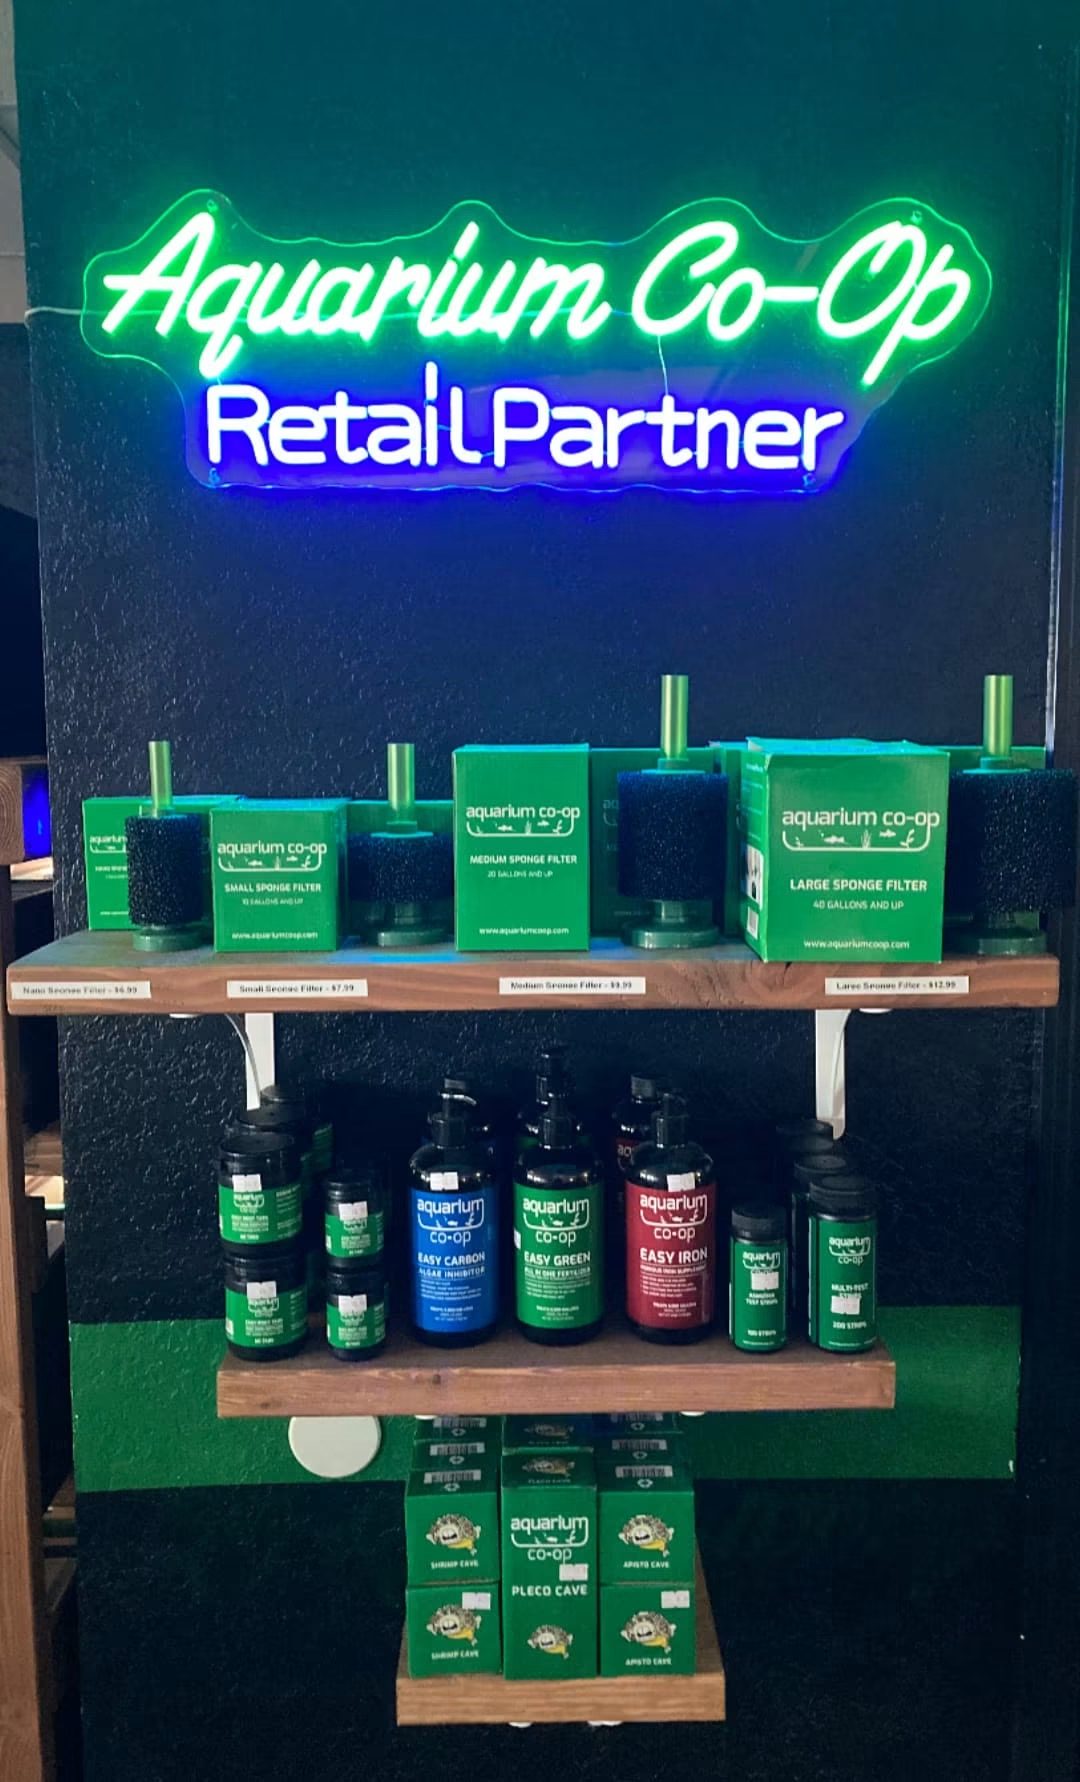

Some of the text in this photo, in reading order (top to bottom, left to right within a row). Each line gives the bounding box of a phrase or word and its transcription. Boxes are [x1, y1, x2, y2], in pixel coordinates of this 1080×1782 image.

[102, 211, 973, 387] Aquarium Co-Op
[206, 361, 845, 471] Retail Partner
[466, 805, 580, 821] aquarium co-op
[782, 808, 877, 831] aquarium
[882, 809, 940, 828] co-op
[217, 841, 327, 856] aquarium co-op
[470, 855, 577, 864] MEDIUM SPONGE FILTER
[224, 883, 321, 892] SMALL SPONGE FILTER
[790, 879, 927, 891] LARGE SPONGE FILTER
[813, 900, 904, 910] 40 GALLONS AND UP
[479, 927, 569, 936] www.aquariumcoop.com
[803, 939, 910, 951] www.aquariumcoop.com
[417, 1199, 484, 1218] aquarium
[523, 1199, 589, 1218] aquarium
[640, 1195, 707, 1214] aquarium
[430, 1231, 471, 1247] co-op
[535, 1231, 576, 1247] co-op
[654, 1227, 696, 1243] co-op
[829, 1237, 870, 1247] aquarium
[418, 1251, 485, 1266] EASY CARBON
[524, 1251, 591, 1266] EASY GREEN
[640, 1247, 708, 1264] EASY IRON
[743, 1252, 780, 1261] aquarium
[511, 1515, 589, 1535] aquarium
[528, 1548, 572, 1564] co-op
[460, 1560, 479, 1568] CAVE
[650, 1560, 669, 1568] CAVE
[512, 1585, 588, 1597] PLECO CAVE
[460, 1650, 479, 1658] CAVE
[653, 1657, 672, 1665] CAVE
